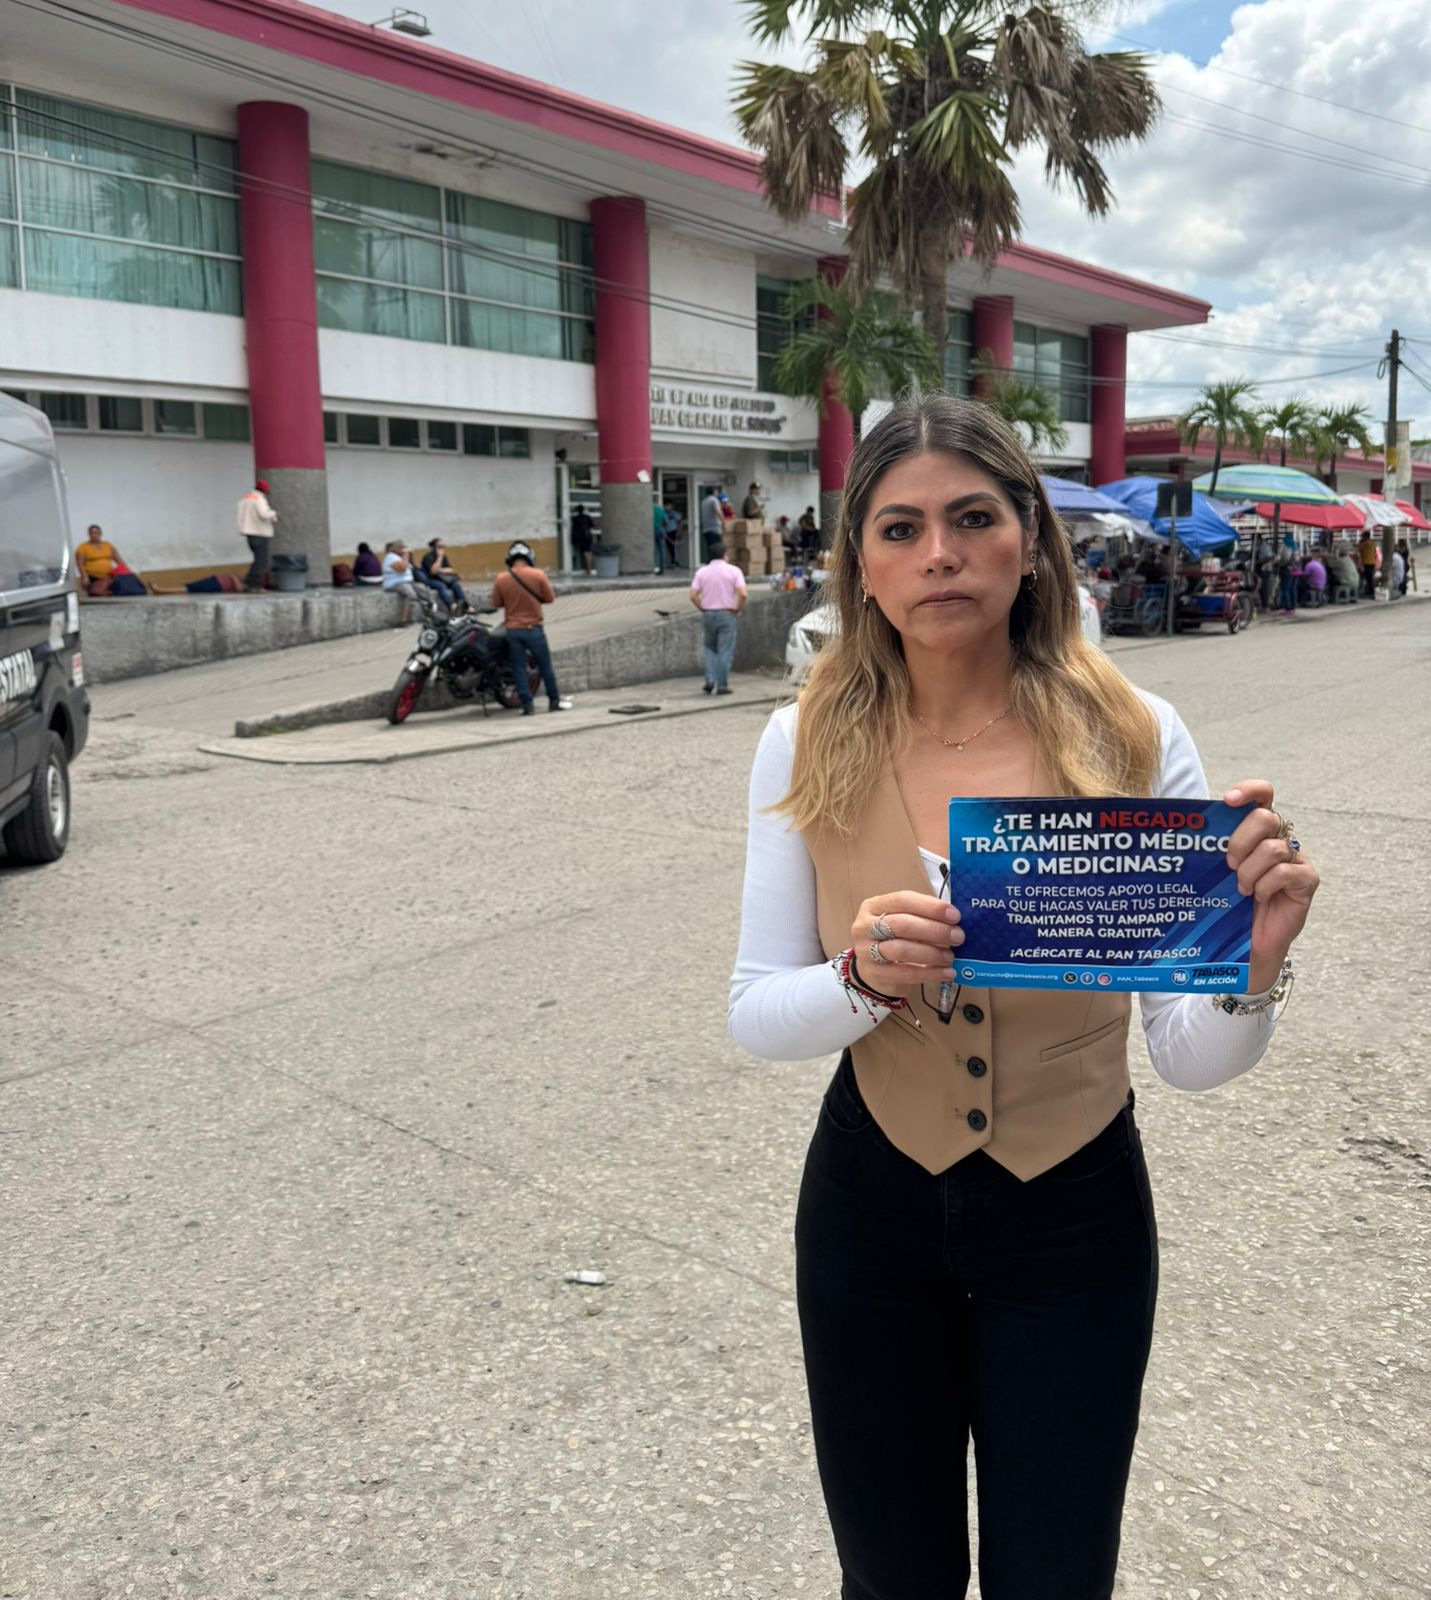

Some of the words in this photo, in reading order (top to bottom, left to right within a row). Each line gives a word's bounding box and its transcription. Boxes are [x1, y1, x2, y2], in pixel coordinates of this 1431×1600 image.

[993, 814, 1032, 834] ¿TE
[1040, 812, 1092, 830] HAN
[1100, 811, 1204, 830] NEGADO
[962, 832, 1133, 852] TRATAMIENTO
[1012, 857, 1030, 875] O
[1038, 855, 1184, 875] MEDICINAS?
[1006, 886, 1022, 897] TE
[1025, 886, 1105, 897] OFRECEMOS
[1108, 884, 1153, 897] APOYO
[1157, 883, 1197, 895] LEGAL
[971, 898, 1006, 909] PARA
[1009, 899, 1036, 913] QUE
[1040, 900, 1084, 912] HAGAS
[1087, 899, 1128, 911] VALER
[1132, 898, 1155, 910] TUS
[1159, 896, 1232, 909] DERECHOS.
[1007, 913, 1094, 925] TRAMITAMOS
[1097, 914, 1114, 925] TU
[1118, 911, 1174, 925] AMPARO
[1179, 910, 1196, 922] DE
[1037, 927, 1094, 938] MANERA
[1097, 927, 1166, 939] GRATUITA.
[1010, 946, 1082, 958] ¡ACÉRCATE
[1085, 948, 1102, 958] AL
[1106, 949, 1133, 960] PAN
[1136, 946, 1202, 959] TABASCO!
[1192, 966, 1240, 978] TABASCO
[1193, 978, 1206, 986] EN
[1207, 975, 1238, 986] ACCIÓN
